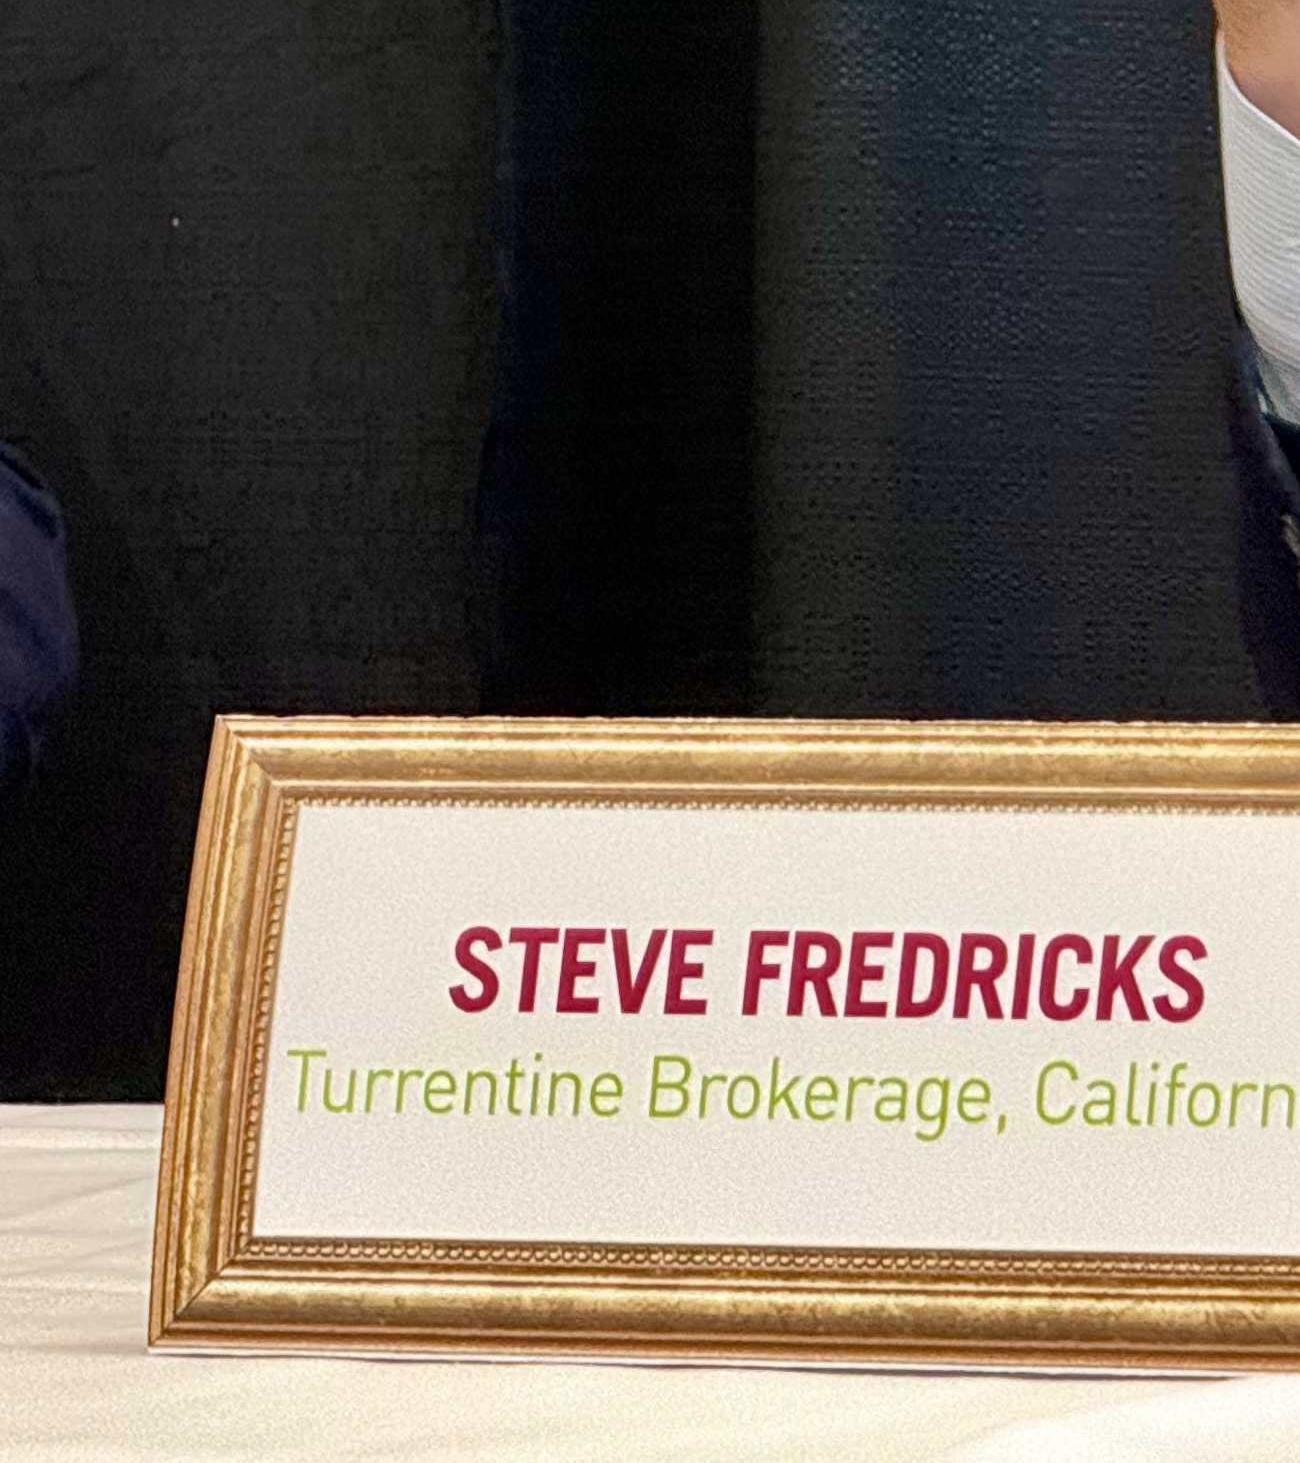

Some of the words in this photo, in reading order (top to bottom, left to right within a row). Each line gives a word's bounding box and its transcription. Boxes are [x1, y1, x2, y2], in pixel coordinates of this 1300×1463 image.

[449, 926, 715, 1015] STEVE
[742, 930, 1209, 1024] FREDRICKS
[288, 1048, 625, 1119] Turrentine
[648, 1054, 1008, 1143] Brokerage,
